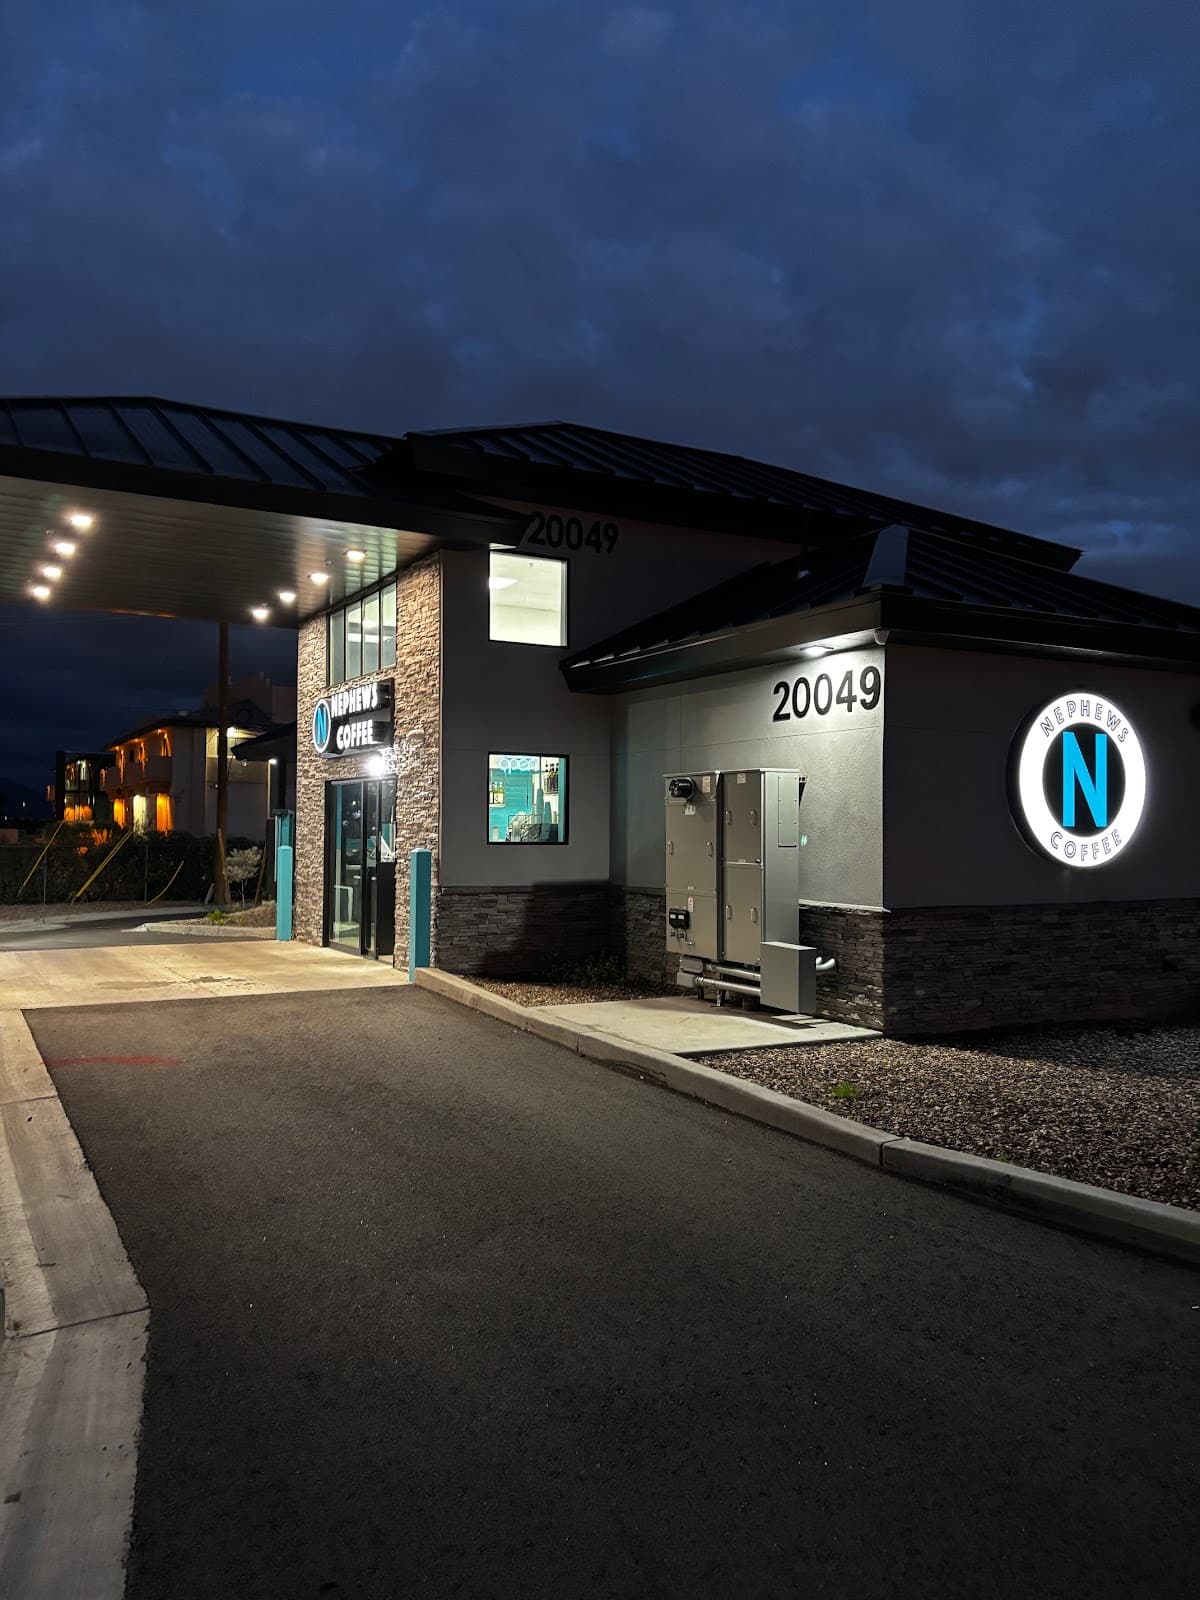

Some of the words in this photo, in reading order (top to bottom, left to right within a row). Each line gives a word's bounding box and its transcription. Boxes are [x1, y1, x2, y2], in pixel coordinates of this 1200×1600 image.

[528, 511, 618, 554] 20049
[331, 682, 378, 718] NEPHEWS
[773, 665, 881, 722] 20049
[317, 706, 327, 745] N
[336, 719, 374, 750] COFFEE
[1040, 699, 1129, 743] NEPHEWS
[1062, 731, 1108, 828] N
[1050, 829, 1122, 861] COFFEE
